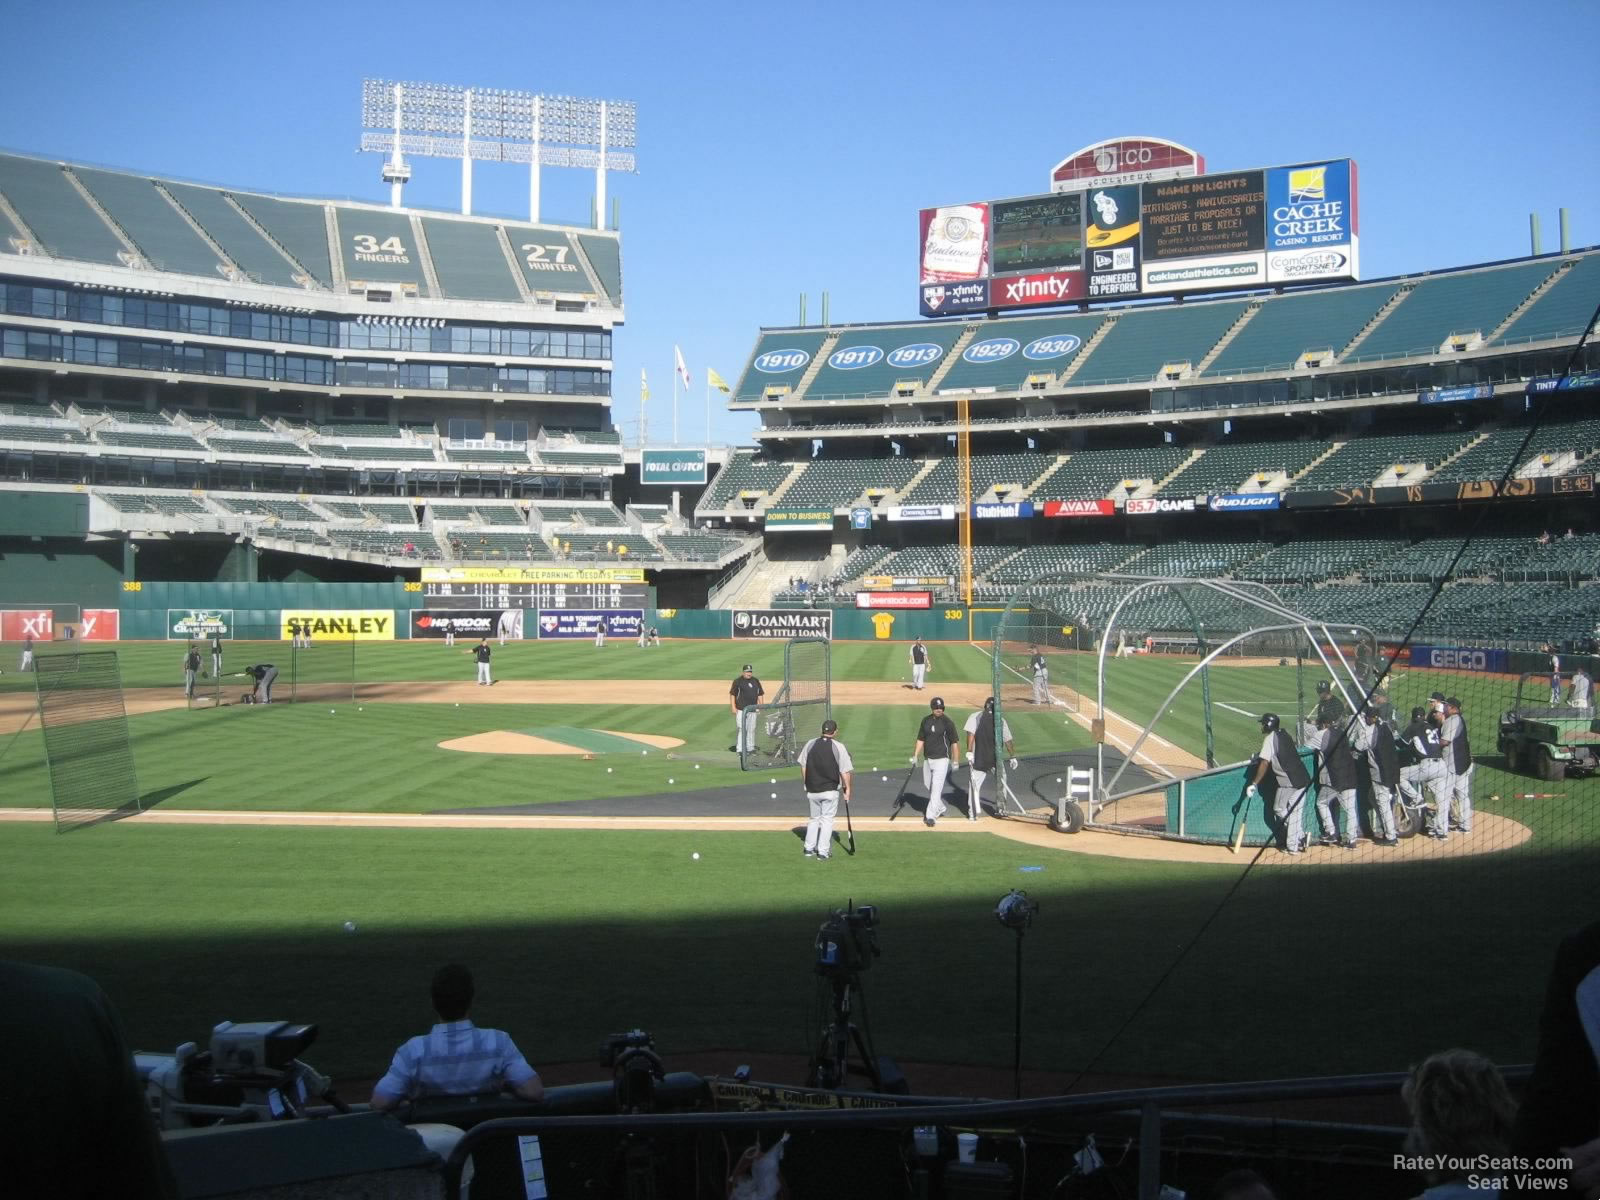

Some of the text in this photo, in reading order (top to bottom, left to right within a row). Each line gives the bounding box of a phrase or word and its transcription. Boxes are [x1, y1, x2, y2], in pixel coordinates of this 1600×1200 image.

[1157, 178, 1247, 197] NAME IN LIGHTS
[1196, 192, 1264, 208] ANNIVERSARIES
[1150, 205, 1257, 225] MARRIAGE PROPOSALS OR
[1273, 201, 1343, 221] CACHE
[1162, 218, 1242, 235] JUST TO BE NICE!
[1274, 217, 1343, 237] CREEK
[353, 234, 407, 255] 34
[1275, 233, 1343, 246] CASINO RESORT
[355, 253, 410, 265] FINGERS
[522, 244, 569, 264] 27
[528, 262, 578, 273] HUNTER
[1149, 265, 1257, 281] oaklandathletics.com
[1284, 262, 1337, 272] SPORTSNET
[1091, 272, 1137, 286] ENGINEERED
[1089, 285, 1099, 295] TO
[970, 342, 1015, 358] 1929
[1030, 339, 1074, 355] 1930
[761, 354, 805, 368] 1910
[836, 350, 878, 365] 1911
[895, 347, 939, 363] 1913
[645, 462, 704, 472] TOTAL CLUTCH
[1407, 486, 1423, 502] VS
[1059, 501, 1099, 512] AVAYA
[1127, 500, 1155, 512] 95.7
[1160, 499, 1195, 511] GAME
[1215, 496, 1275, 507] BUD LIGHT
[767, 511, 831, 521] DOWN TO BUSINESS
[521, 571, 540, 580] FREE
[541, 569, 575, 579] PARKING
[576, 569, 611, 579] TUESDAYS
[123, 582, 142, 591] 388
[404, 583, 422, 592] 362
[870, 597, 928, 605] overstock.com
[945, 609, 962, 620] 330
[287, 617, 388, 634] STANLEY
[753, 628, 771, 637] CAR
[772, 628, 797, 637] TITLE
[1431, 650, 1486, 669] GEICO
